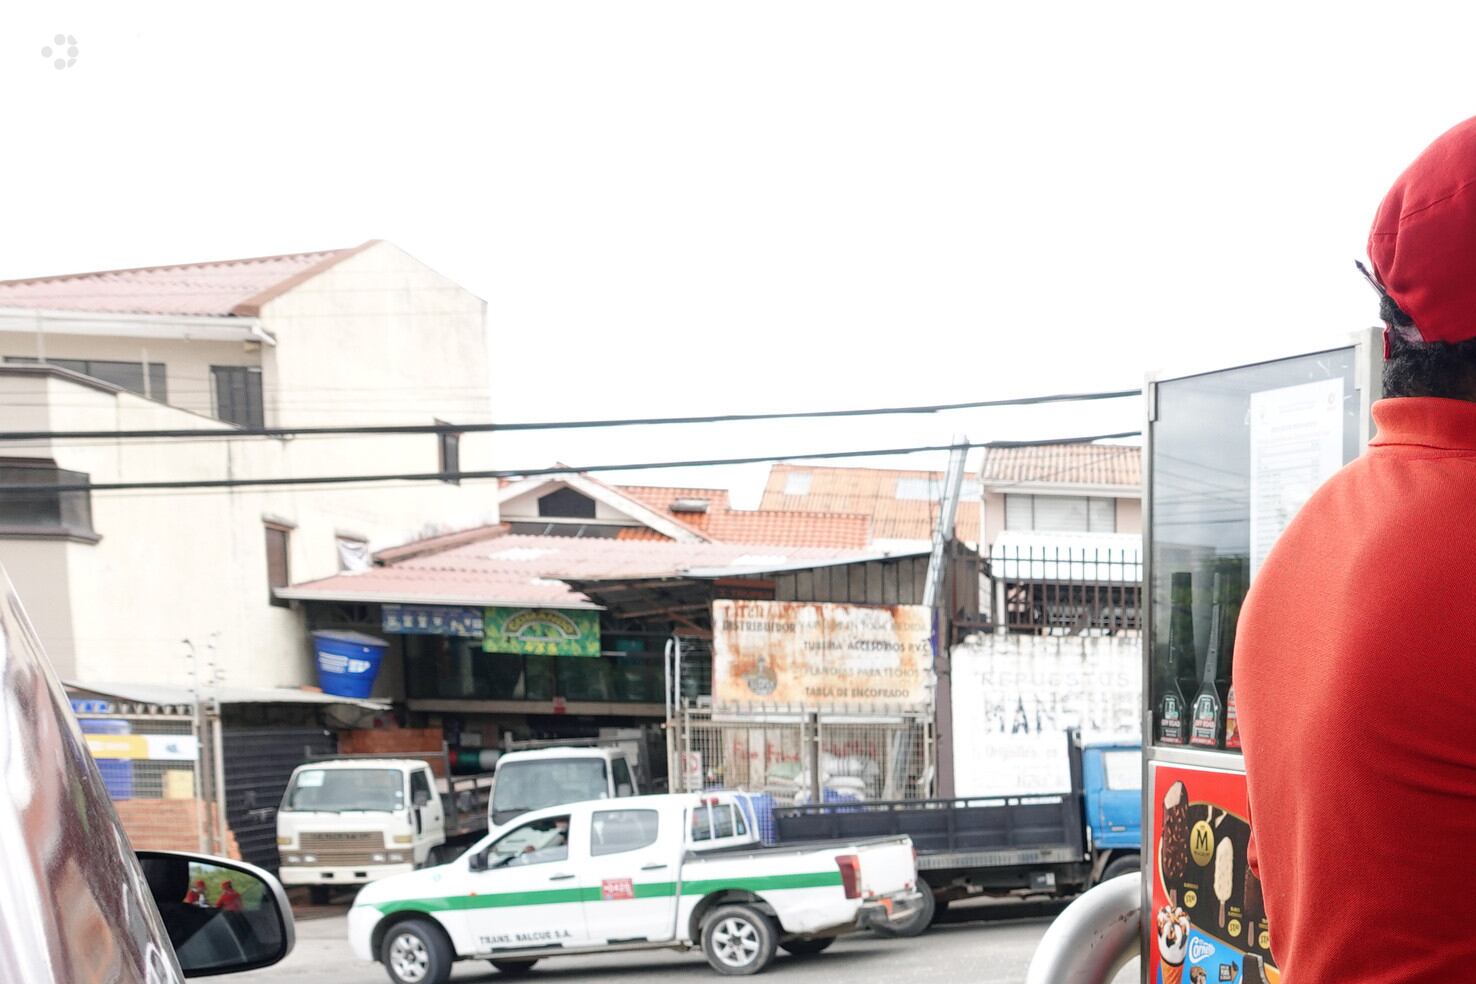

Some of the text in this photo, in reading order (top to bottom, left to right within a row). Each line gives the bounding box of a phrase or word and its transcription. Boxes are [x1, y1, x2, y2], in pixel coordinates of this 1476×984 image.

[805, 686, 833, 697] TABLA
[836, 688, 848, 697] DE
[1196, 829, 1208, 852] M
